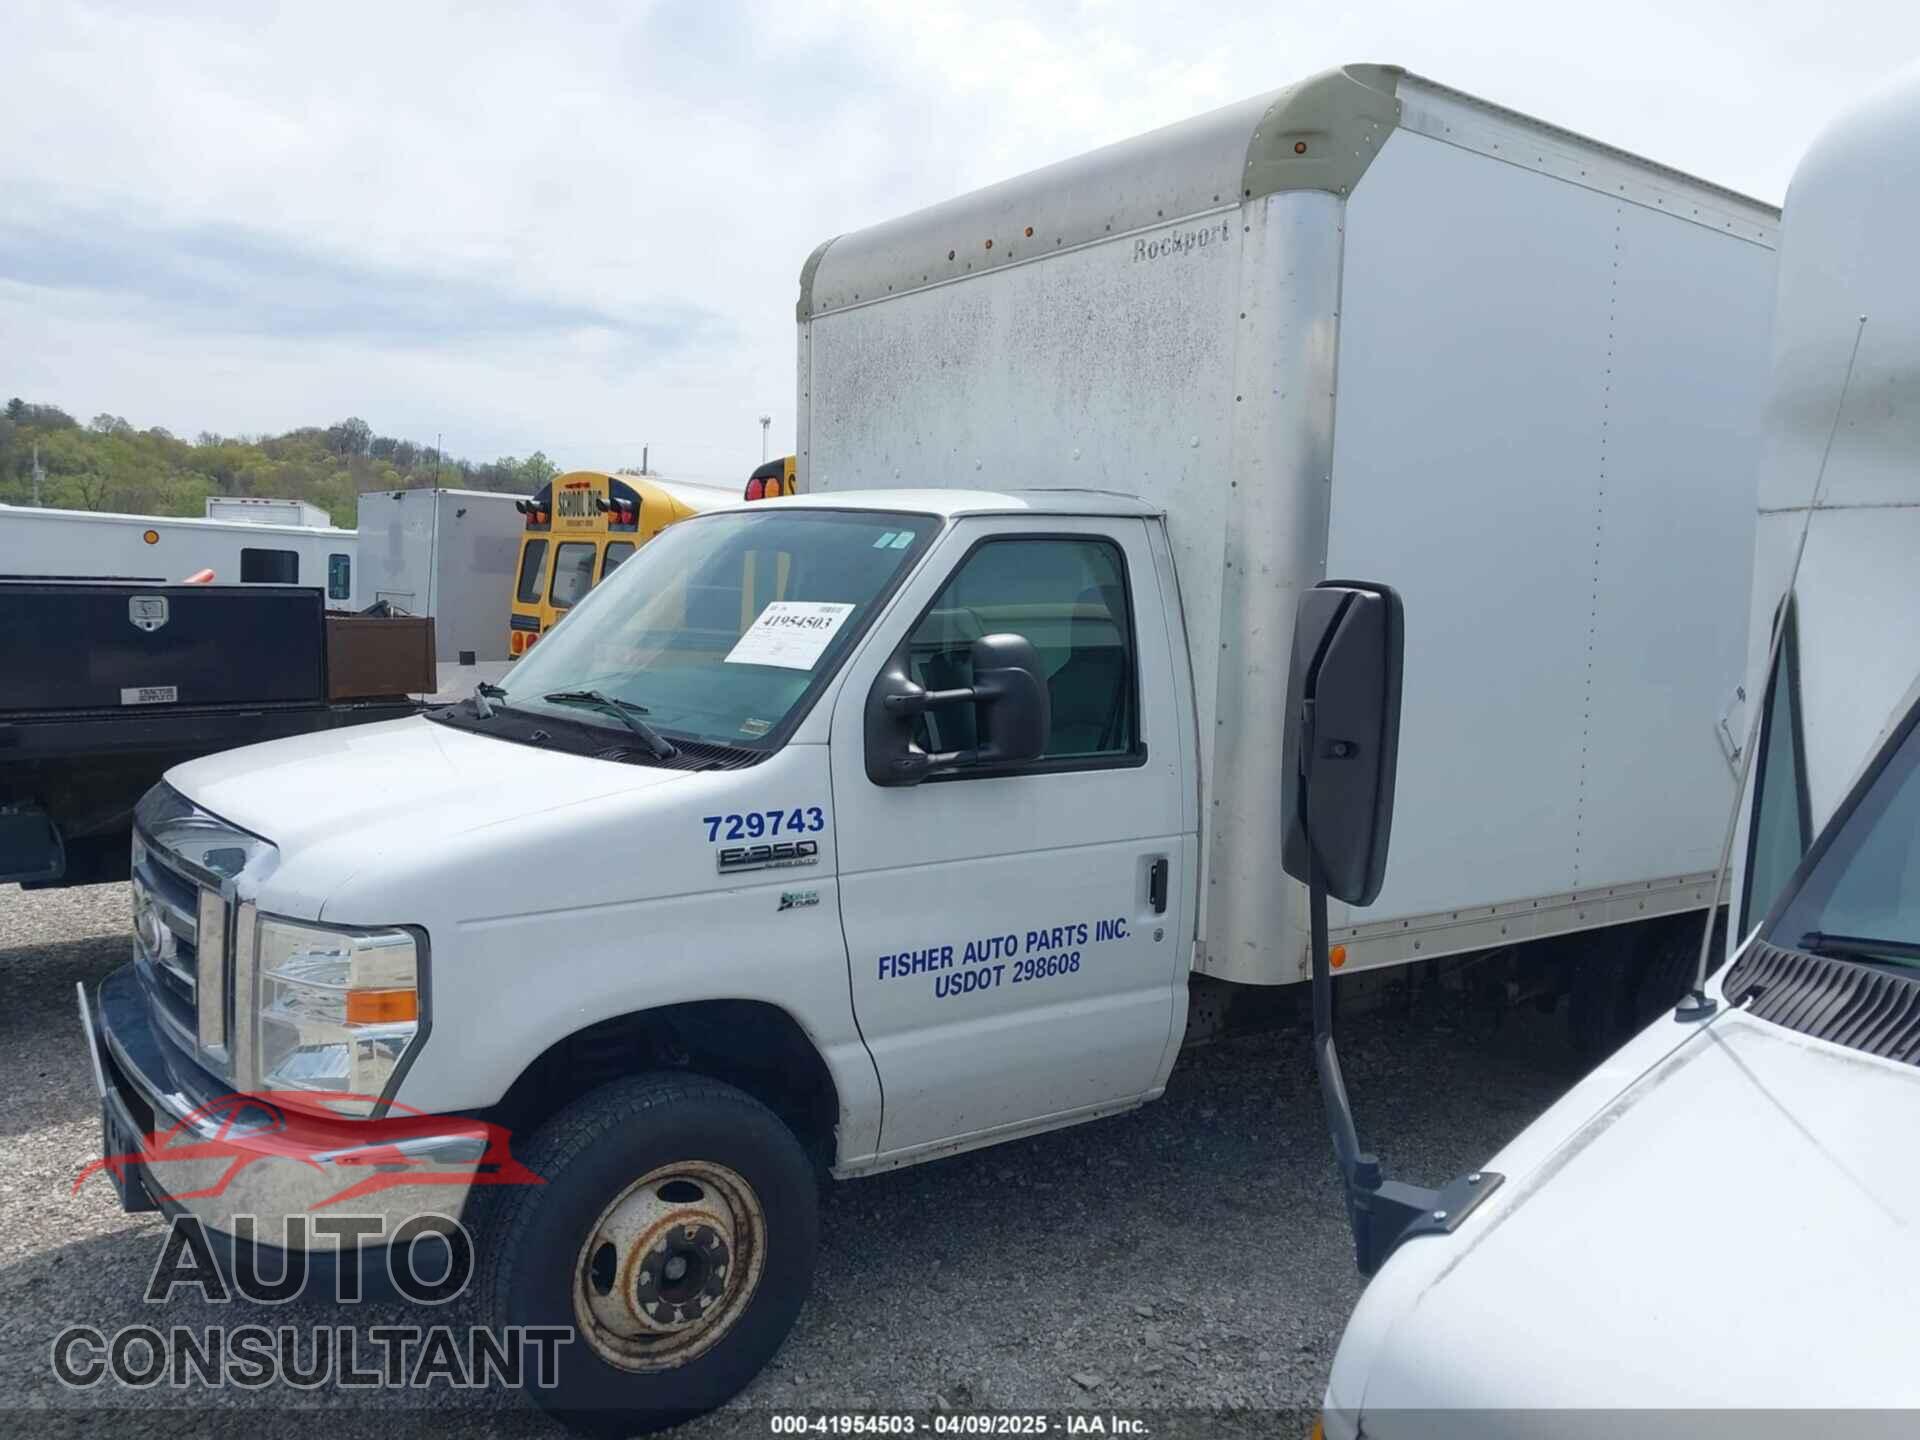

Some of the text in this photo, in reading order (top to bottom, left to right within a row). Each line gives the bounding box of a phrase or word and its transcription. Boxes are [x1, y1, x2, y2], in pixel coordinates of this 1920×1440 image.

[1134, 218, 1229, 262] Rockport
[558, 489, 585, 517] SCHOOL
[764, 615, 832, 630] 41954503
[703, 807, 824, 842] 729743
[878, 917, 1131, 980] FISHER AUTO PARTS INC.
[935, 951, 1081, 998] USDOT 298608
